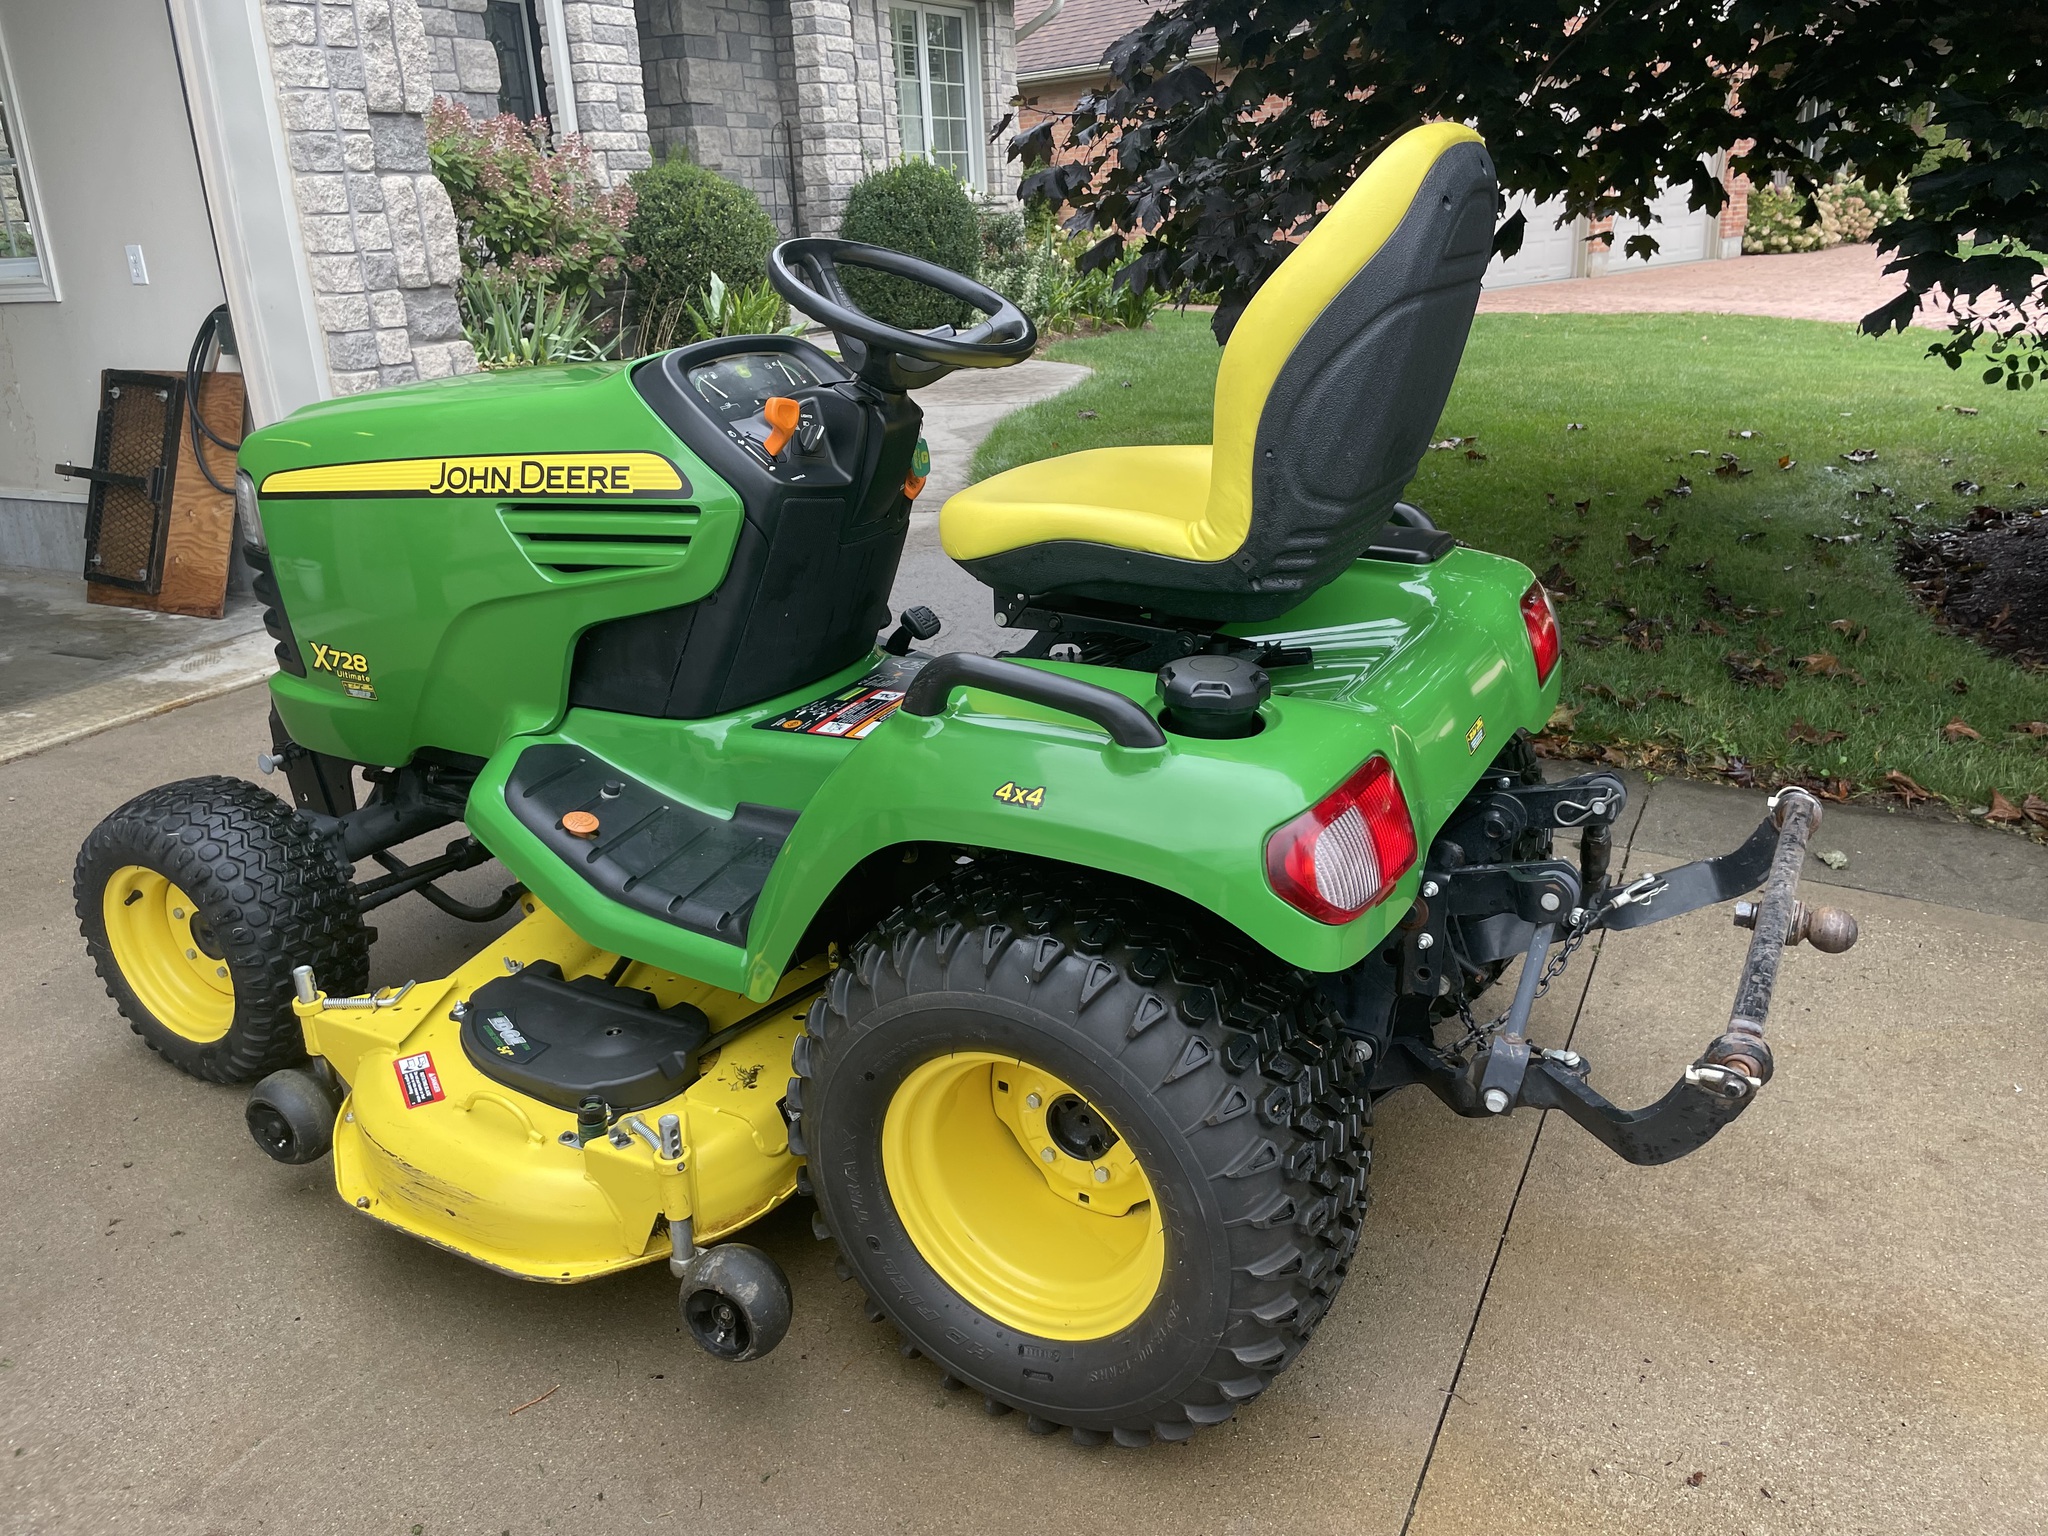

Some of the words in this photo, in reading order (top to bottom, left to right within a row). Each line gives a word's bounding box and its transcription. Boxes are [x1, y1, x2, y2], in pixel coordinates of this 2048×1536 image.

[430, 461, 512, 491] JOHN
[520, 460, 631, 490] DEERE
[309, 642, 368, 673] X728
[336, 669, 371, 683] Ultimate
[995, 782, 1044, 807] 4x4
[487, 1015, 527, 1047] EDGE
[865, 1234, 941, 1322] FIELD
